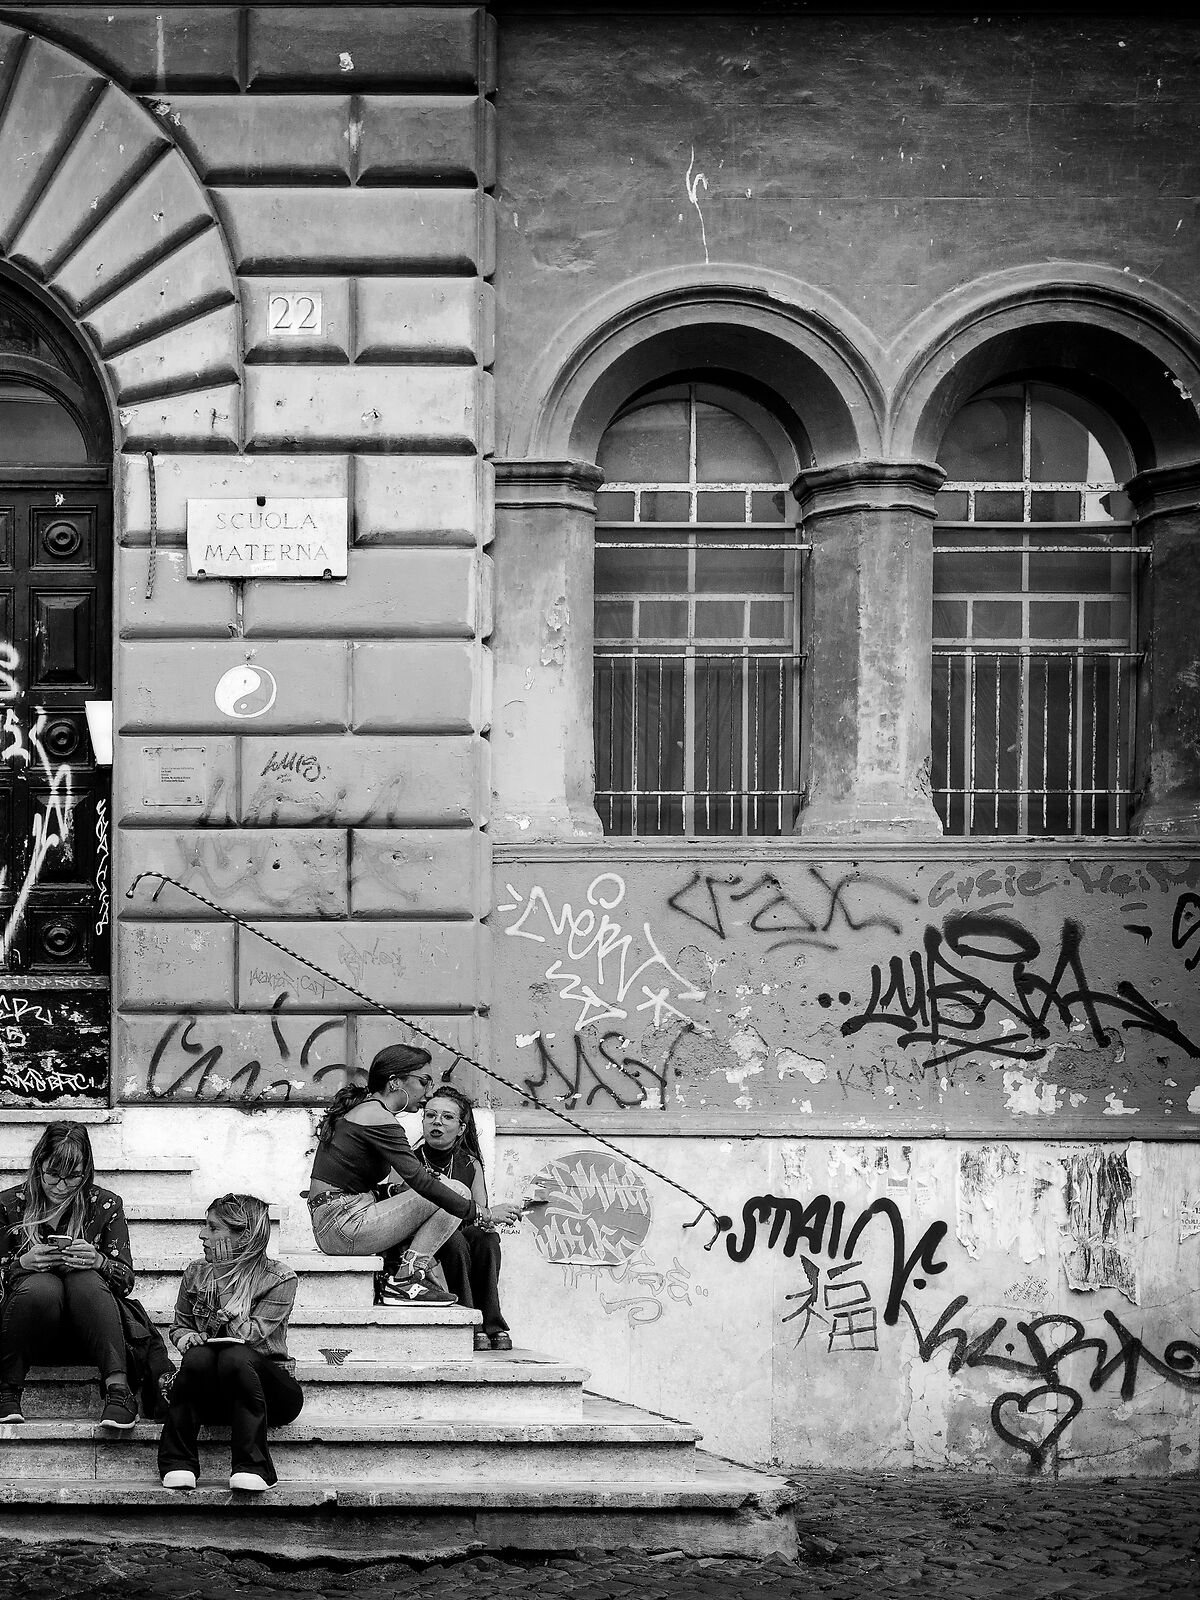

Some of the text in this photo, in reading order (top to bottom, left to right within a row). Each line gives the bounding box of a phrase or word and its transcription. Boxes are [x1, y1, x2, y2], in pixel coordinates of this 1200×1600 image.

[270, 296, 318, 330] 22
[215, 511, 318, 530] SCUOLA
[204, 543, 330, 562] MATERNA
